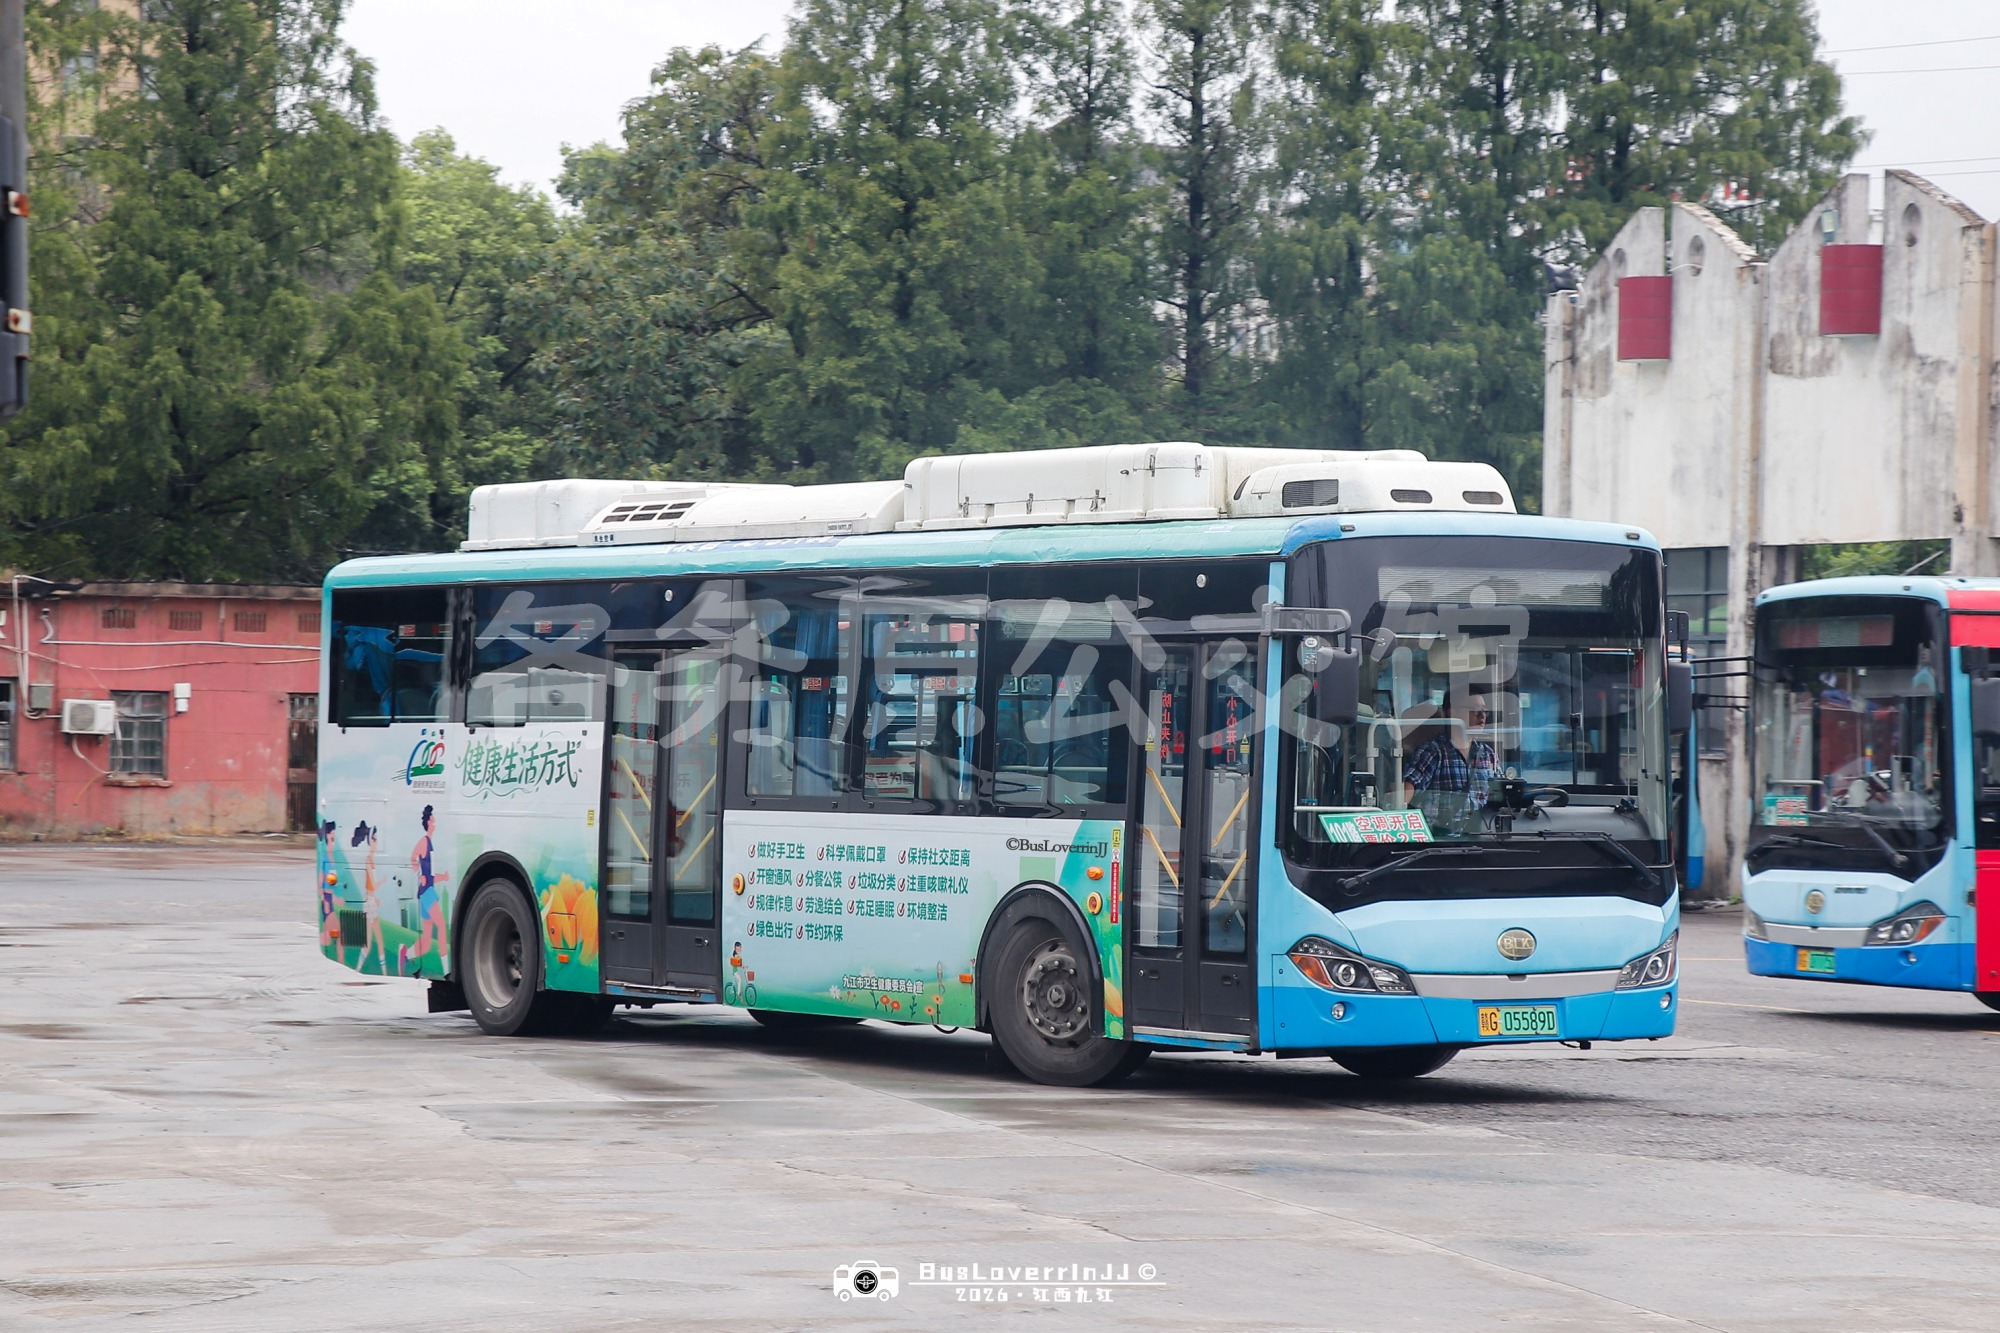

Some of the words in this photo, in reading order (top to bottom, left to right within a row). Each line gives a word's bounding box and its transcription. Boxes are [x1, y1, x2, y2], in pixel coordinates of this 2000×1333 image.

[462, 739, 582, 788] 健康生活方式
[1354, 814, 1424, 831] 空调开启
[757, 841, 805, 860] 做好手卫生
[826, 844, 886, 863] 科学佩戴口罩
[908, 847, 971, 867] 保持社交距离
[756, 868, 792, 886] 开窗通风
[805, 870, 842, 888] 分餐公筷
[858, 873, 896, 891] 垃圾分类
[907, 875, 969, 895] 注重咳嗽礼仪
[755, 895, 793, 913] 规律作息
[805, 897, 843, 916] 劳逸结合
[855, 899, 894, 918] 充足睡眠
[907, 902, 948, 921] 环境整洁
[755, 921, 793, 940] 绿色出行
[805, 923, 843, 943] 节约环保
